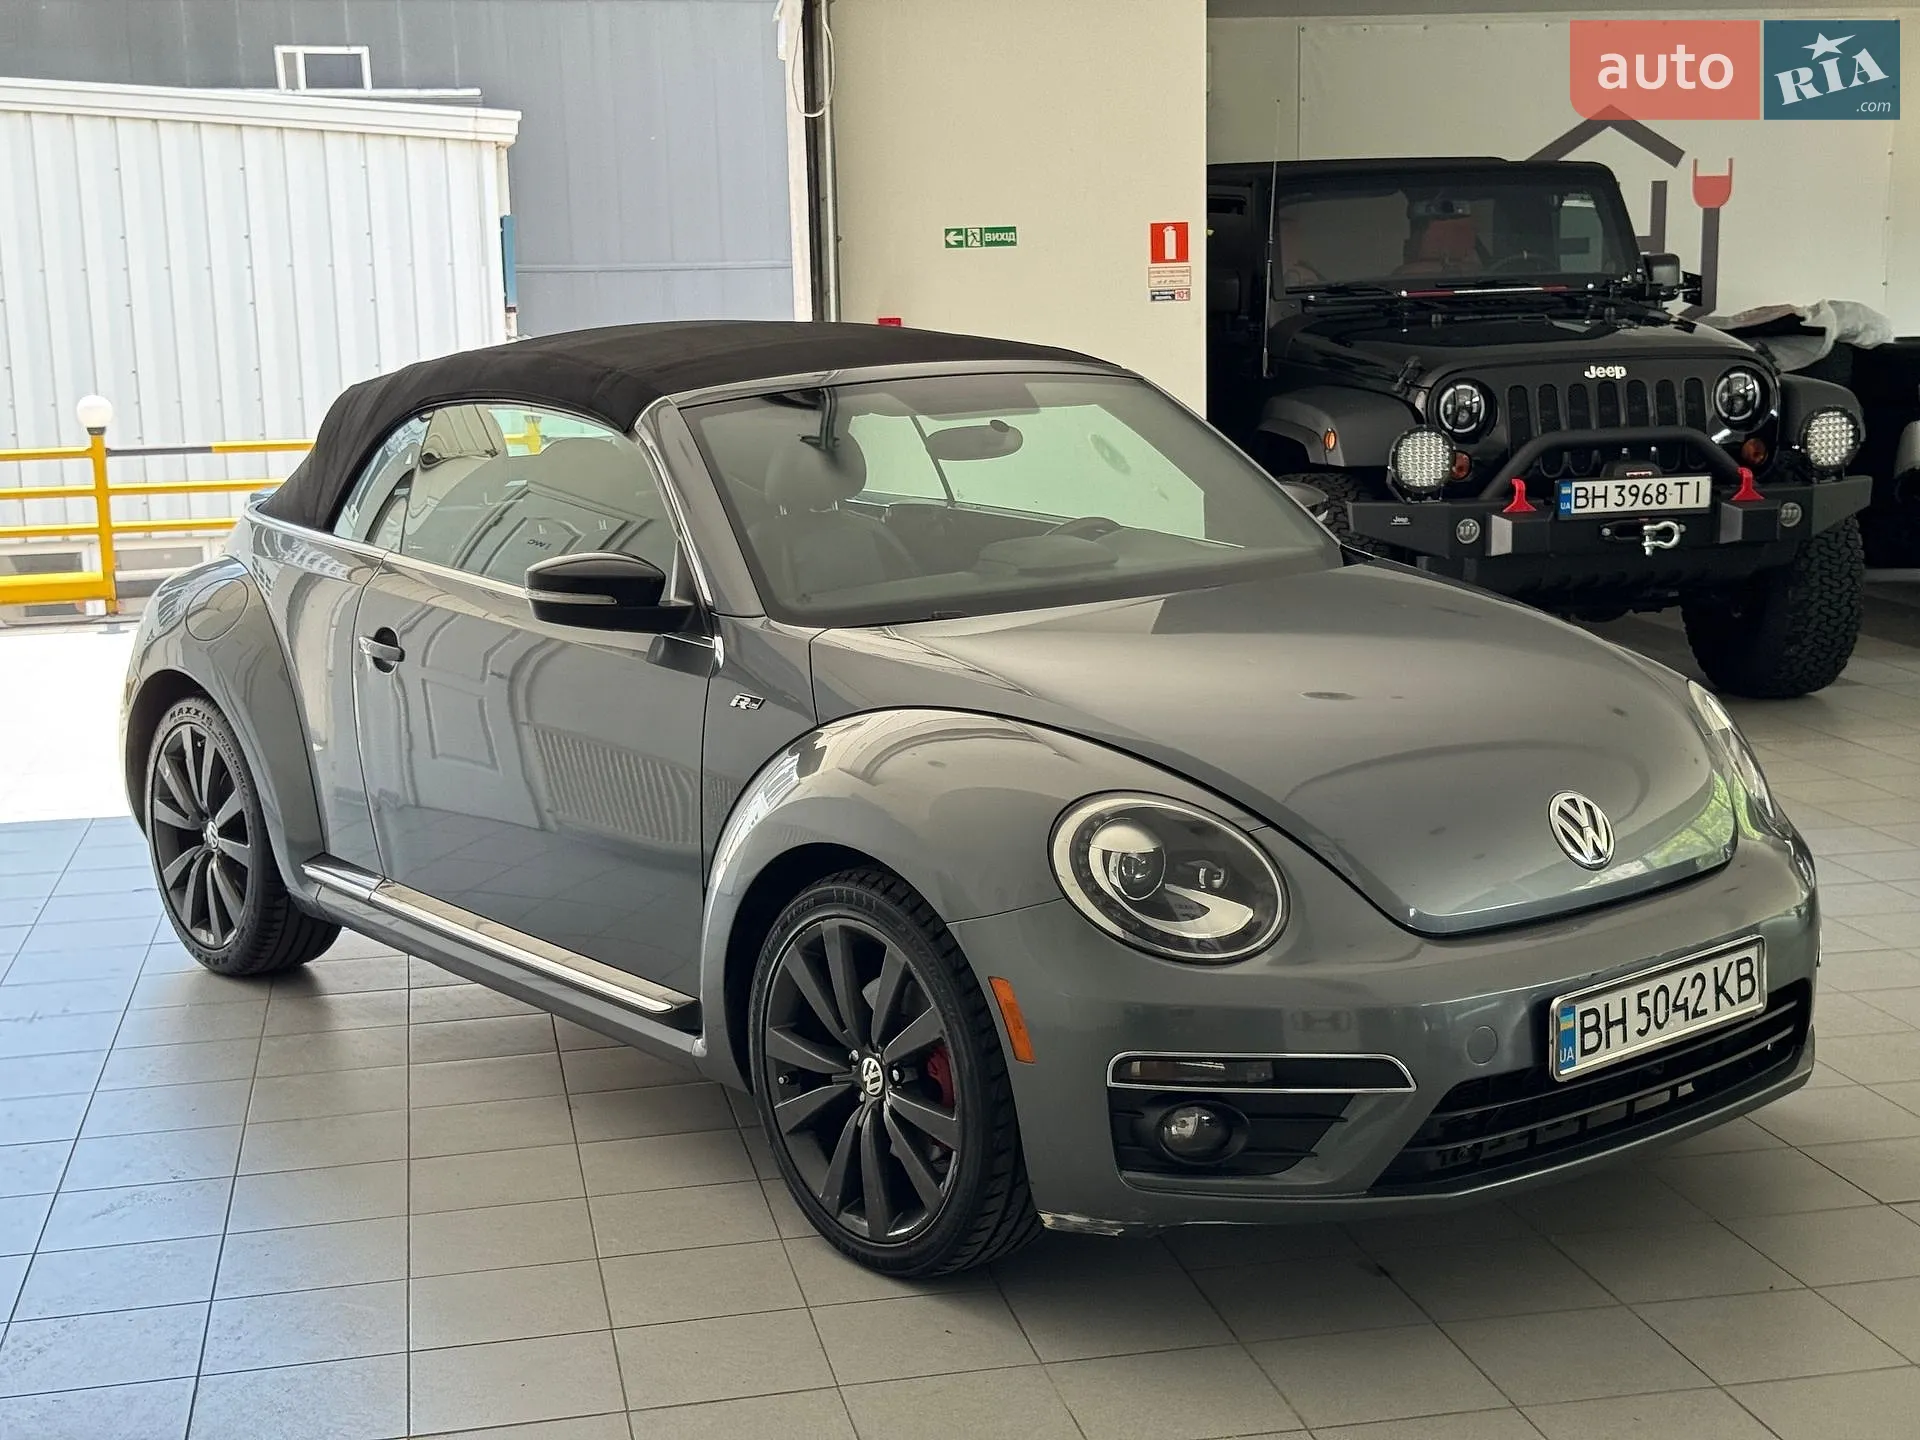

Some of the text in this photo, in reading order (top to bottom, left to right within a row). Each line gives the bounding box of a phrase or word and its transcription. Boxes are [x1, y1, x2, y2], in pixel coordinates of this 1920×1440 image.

[984, 231, 1016, 243] ВИХІД
[1583, 364, 1627, 380] Jeep
[1573, 481, 1701, 510] BH 3968 TI
[1560, 502, 1571, 510] UA
[169, 706, 214, 728] MAXXIS
[1579, 956, 1757, 1057] BH 5042 KB
[1559, 1045, 1575, 1064] UA
